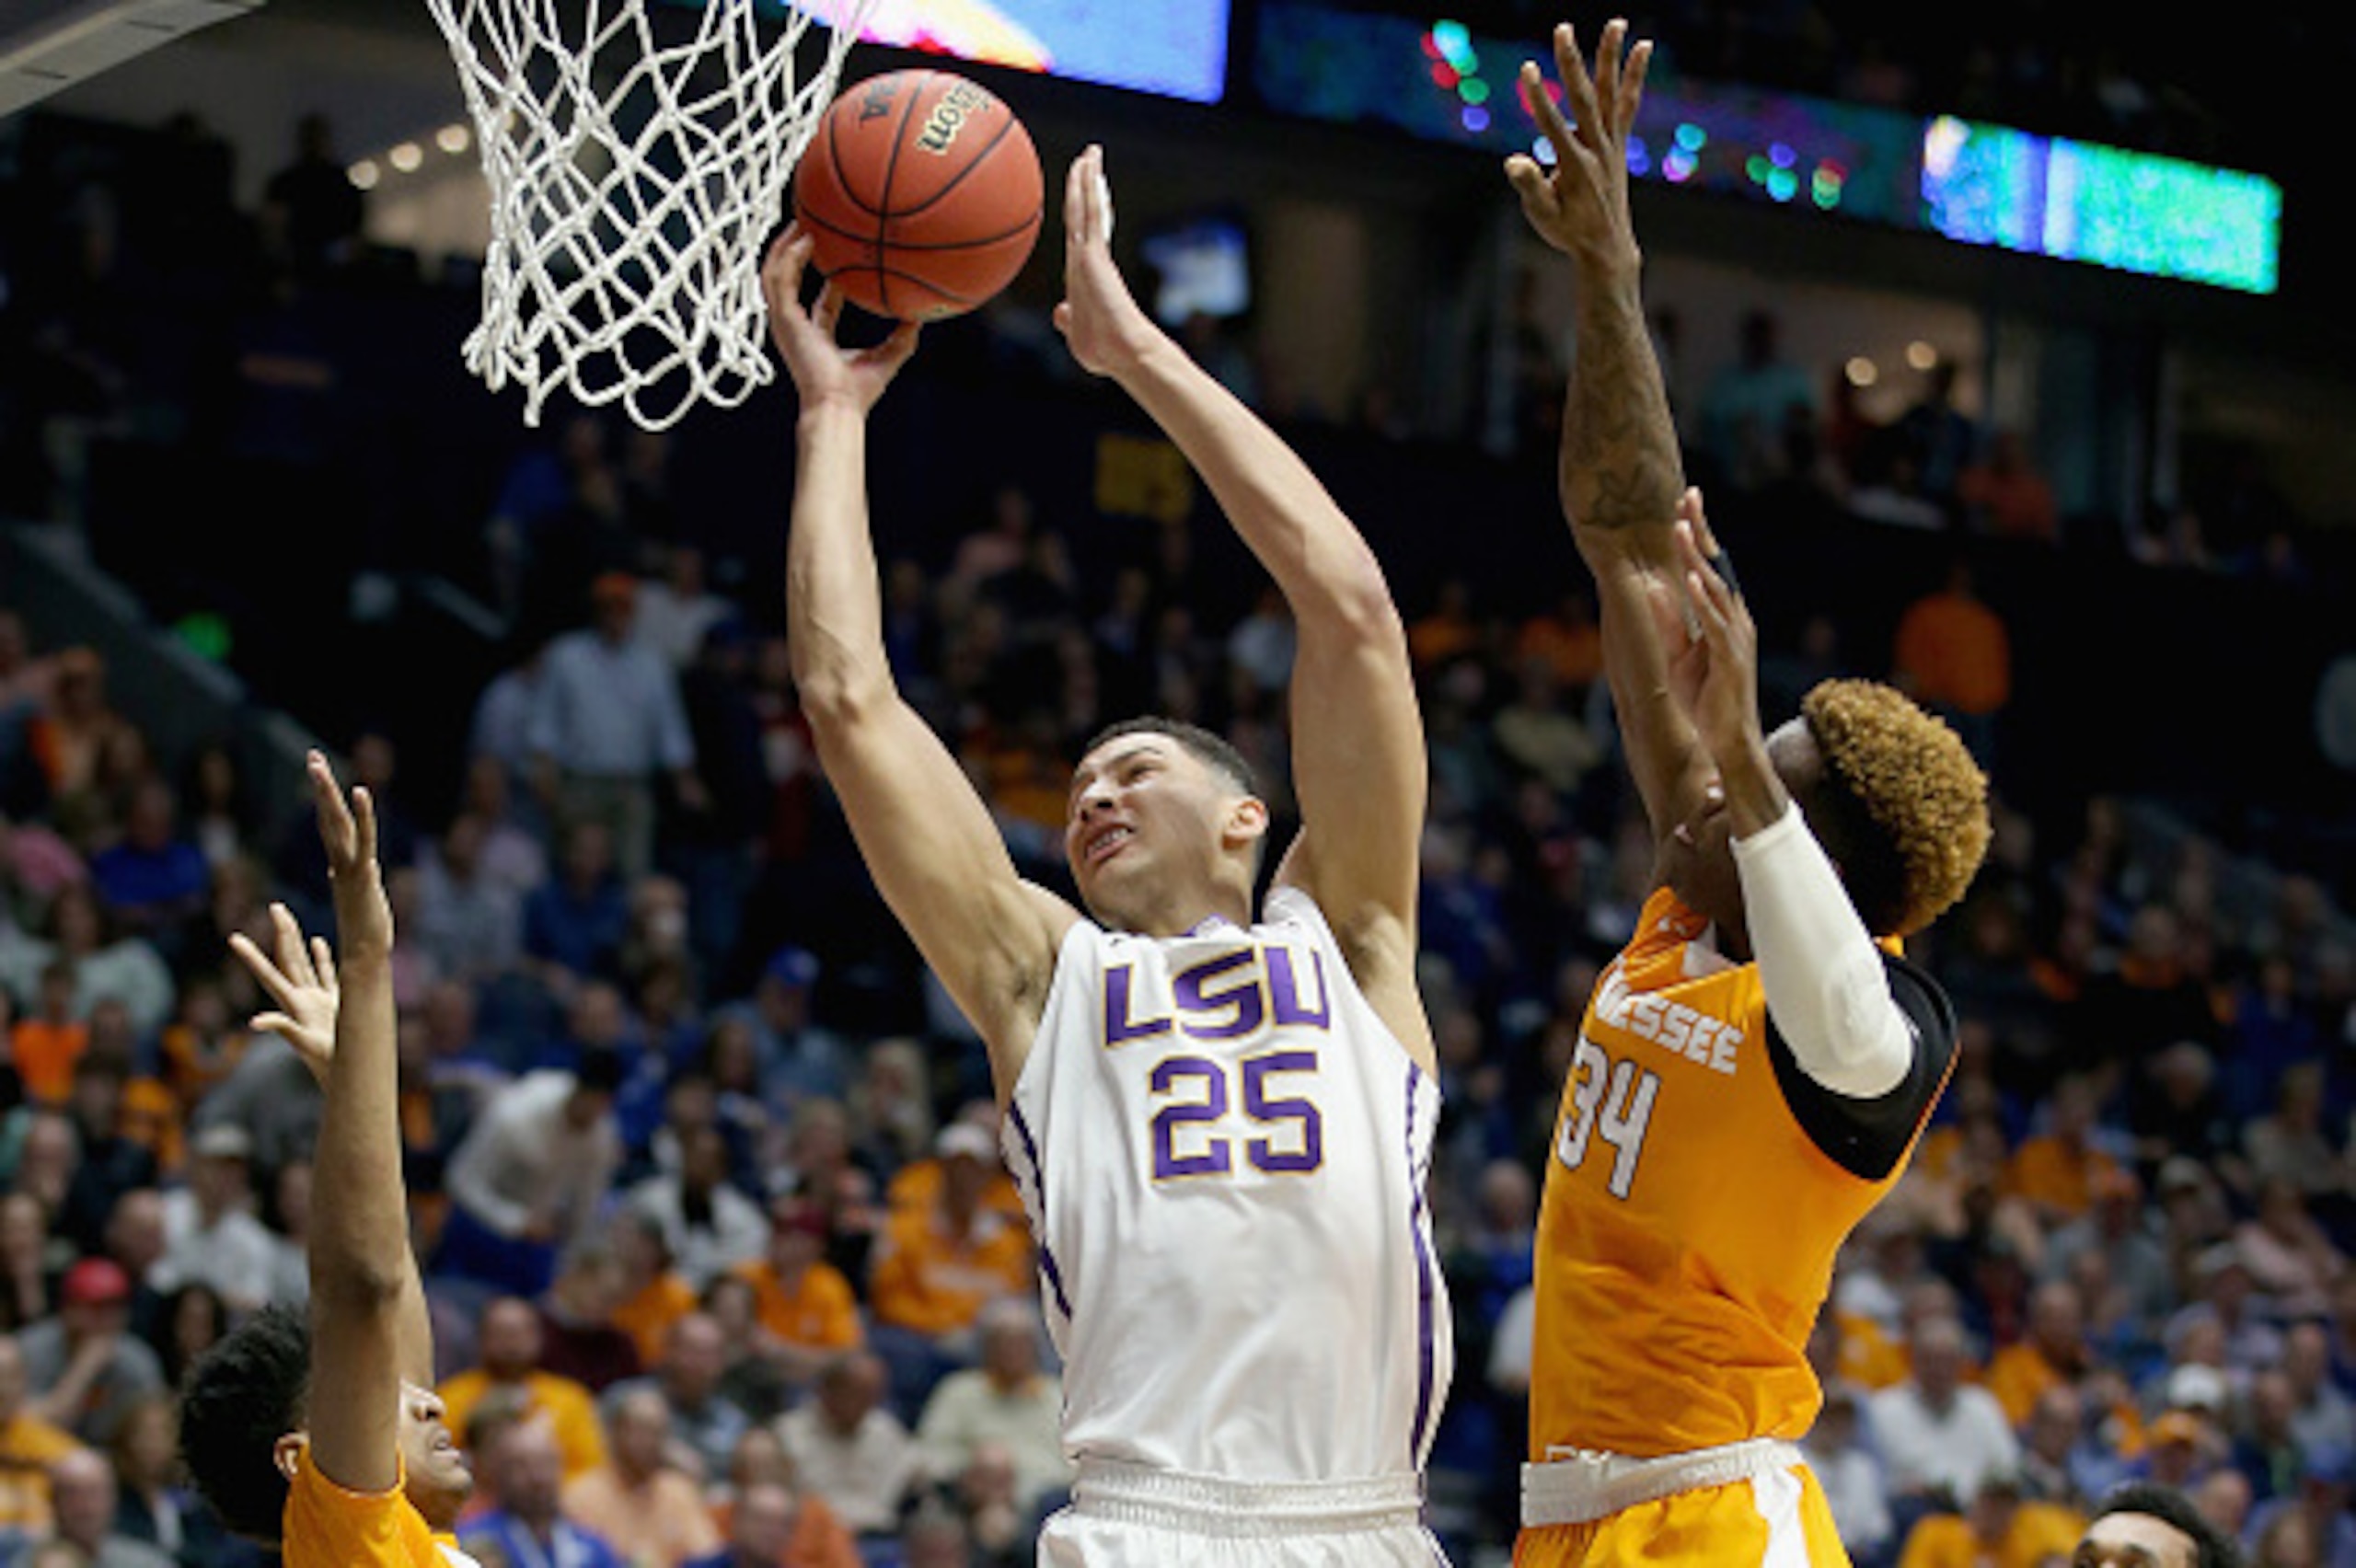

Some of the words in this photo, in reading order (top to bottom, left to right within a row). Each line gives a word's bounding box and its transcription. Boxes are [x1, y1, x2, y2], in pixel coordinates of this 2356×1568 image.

[1103, 944, 1331, 1050] LSU
[1148, 1050, 1324, 1183] 25
[1557, 1032, 1662, 1201] 34
